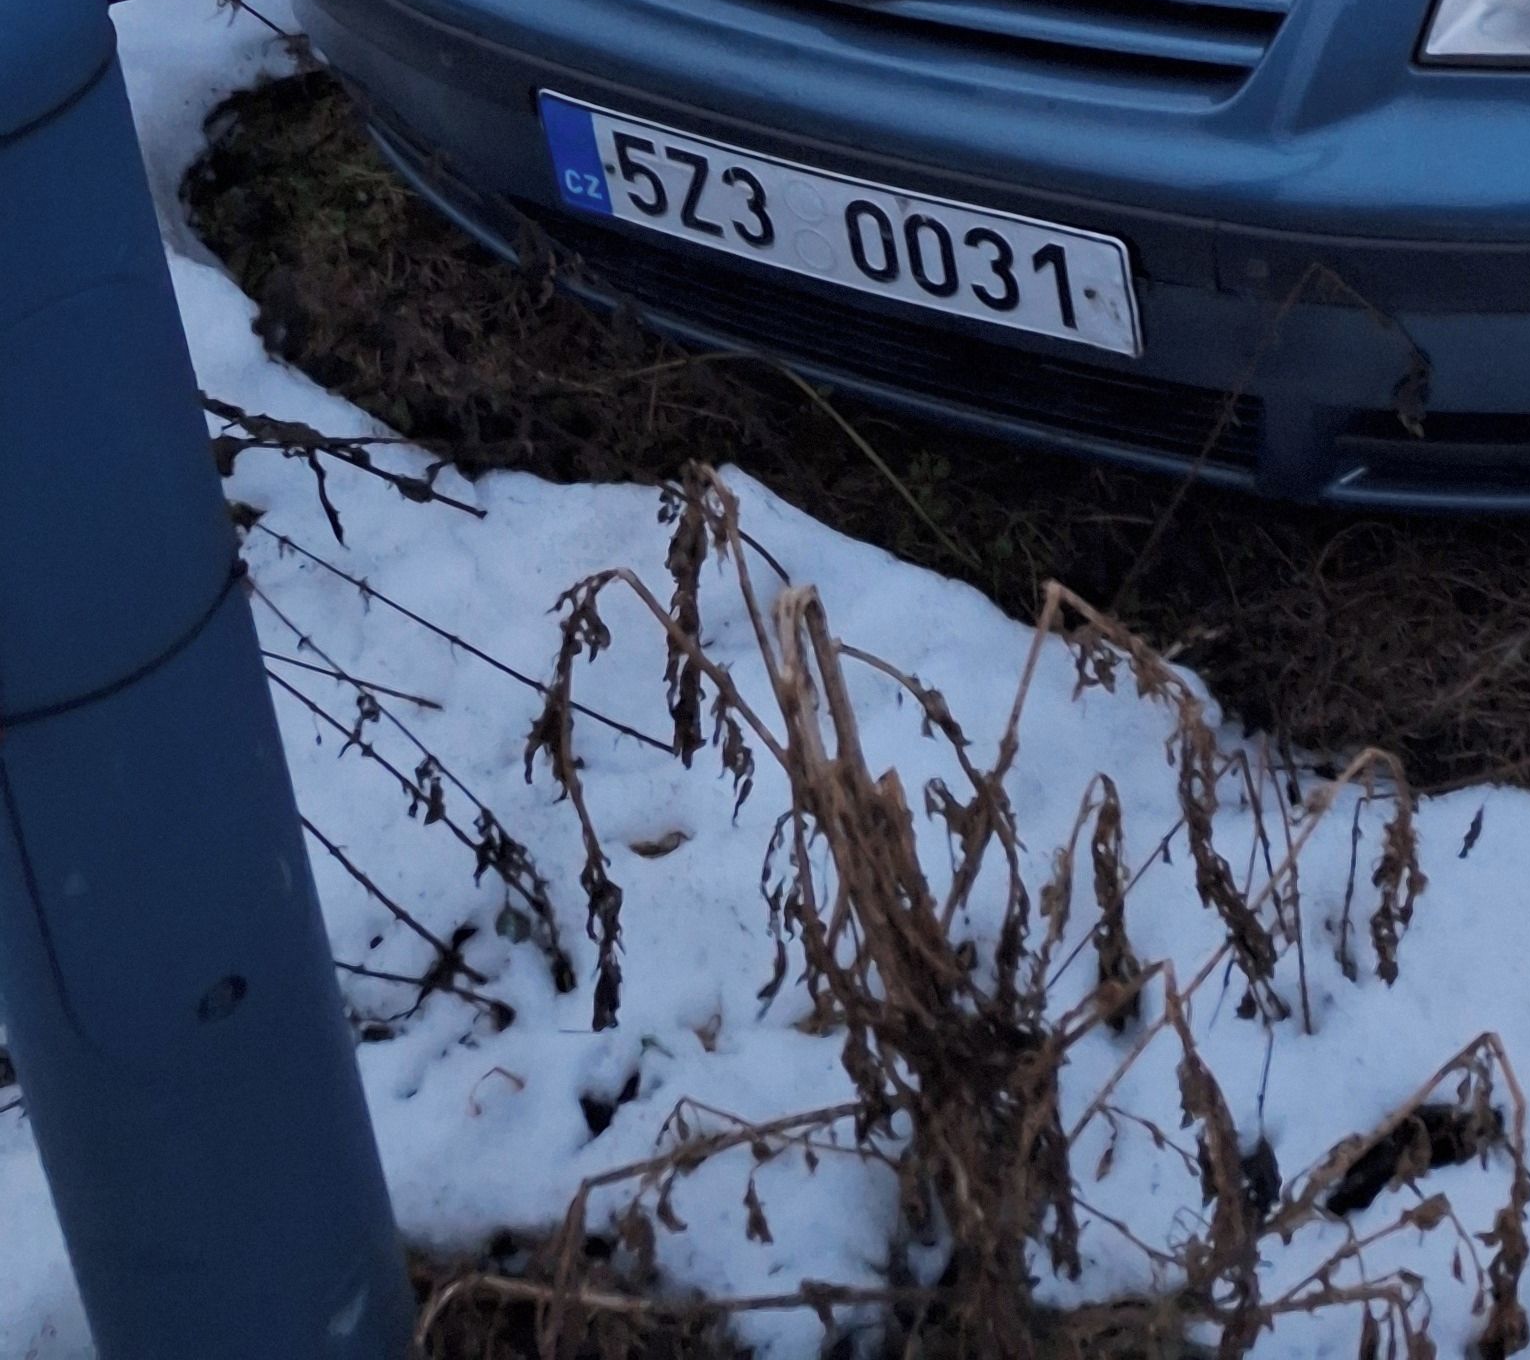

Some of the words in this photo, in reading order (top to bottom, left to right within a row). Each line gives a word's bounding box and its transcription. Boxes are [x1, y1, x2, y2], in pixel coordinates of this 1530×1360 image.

[564, 169, 603, 199] CZ
[611, 130, 774, 247] 5Z3
[844, 198, 1078, 330] 0031
